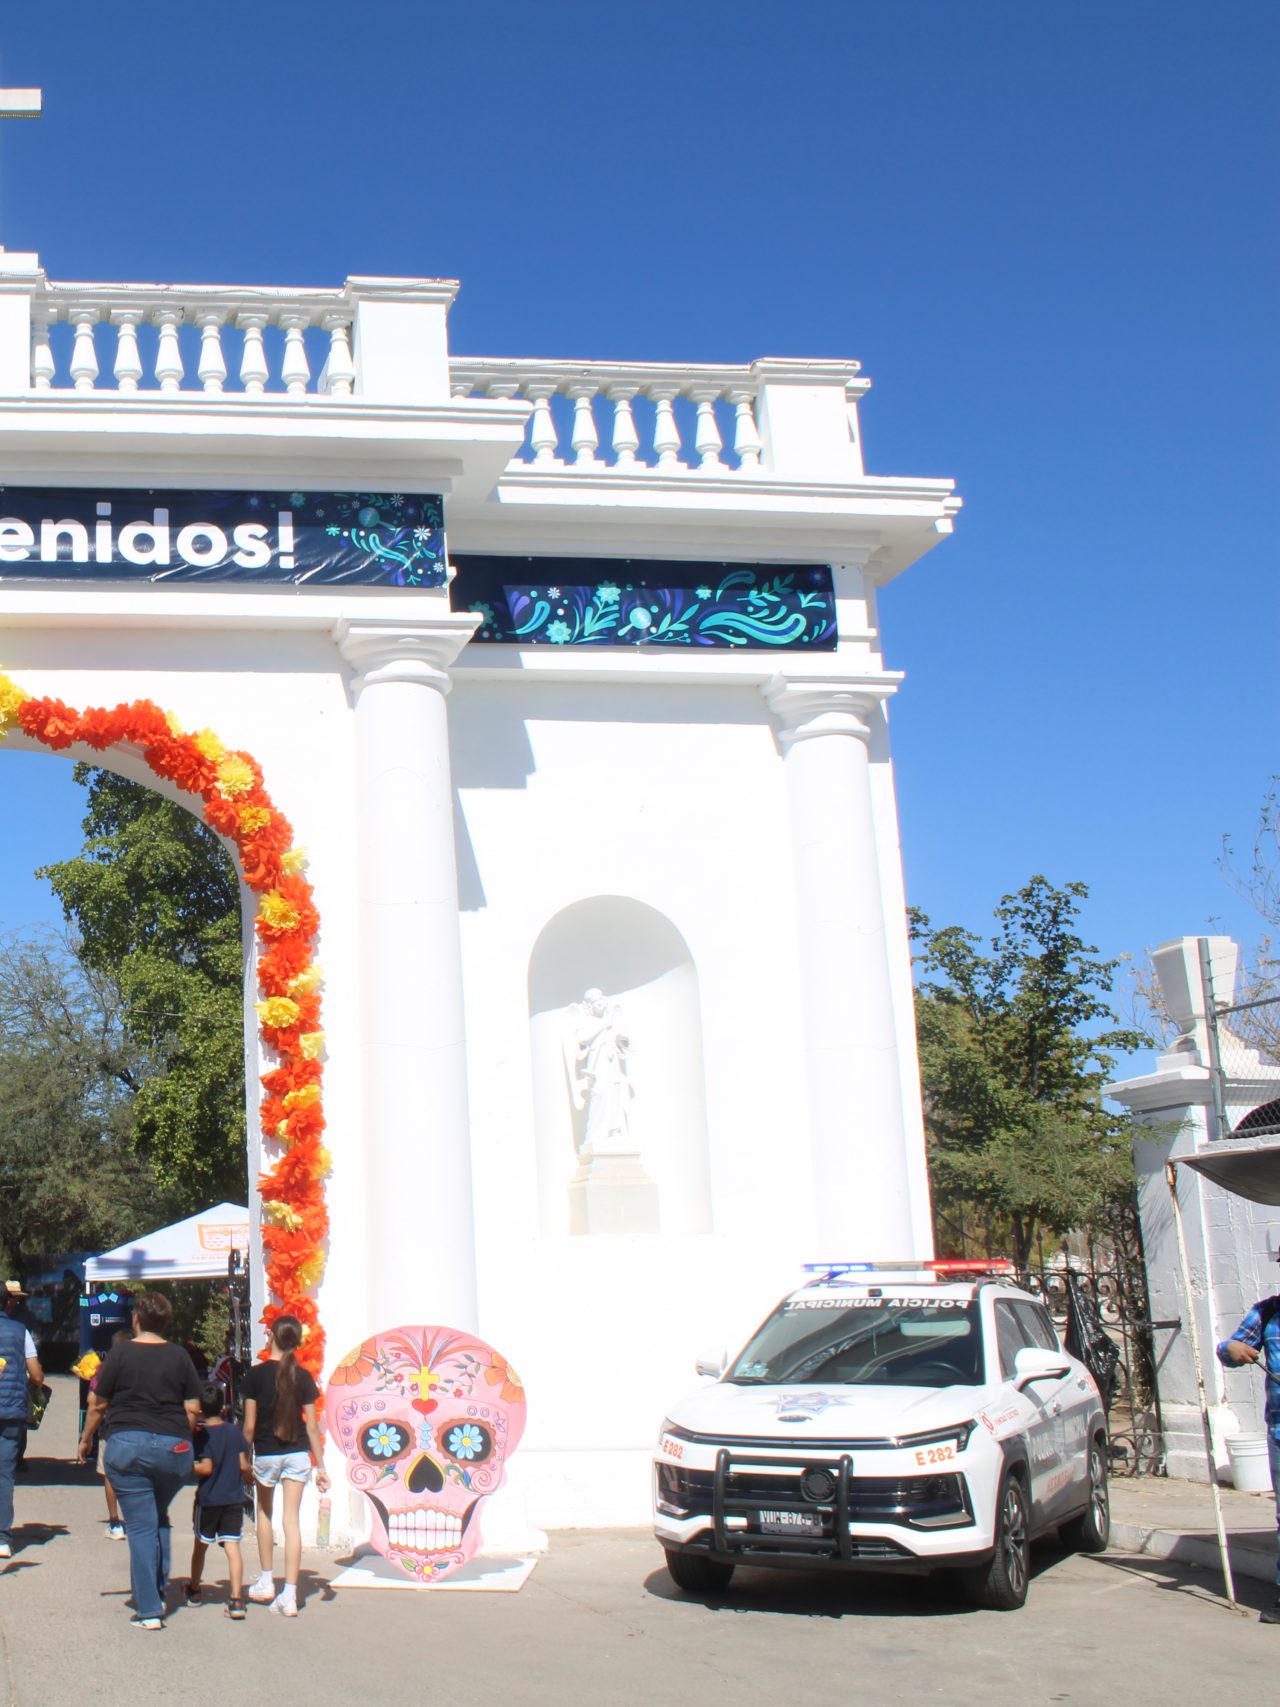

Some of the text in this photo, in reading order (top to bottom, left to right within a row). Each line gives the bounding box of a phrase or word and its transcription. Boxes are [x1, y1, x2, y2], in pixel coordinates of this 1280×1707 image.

[669, 1442, 684, 1459] 282
[915, 1446, 955, 1466] E 282
